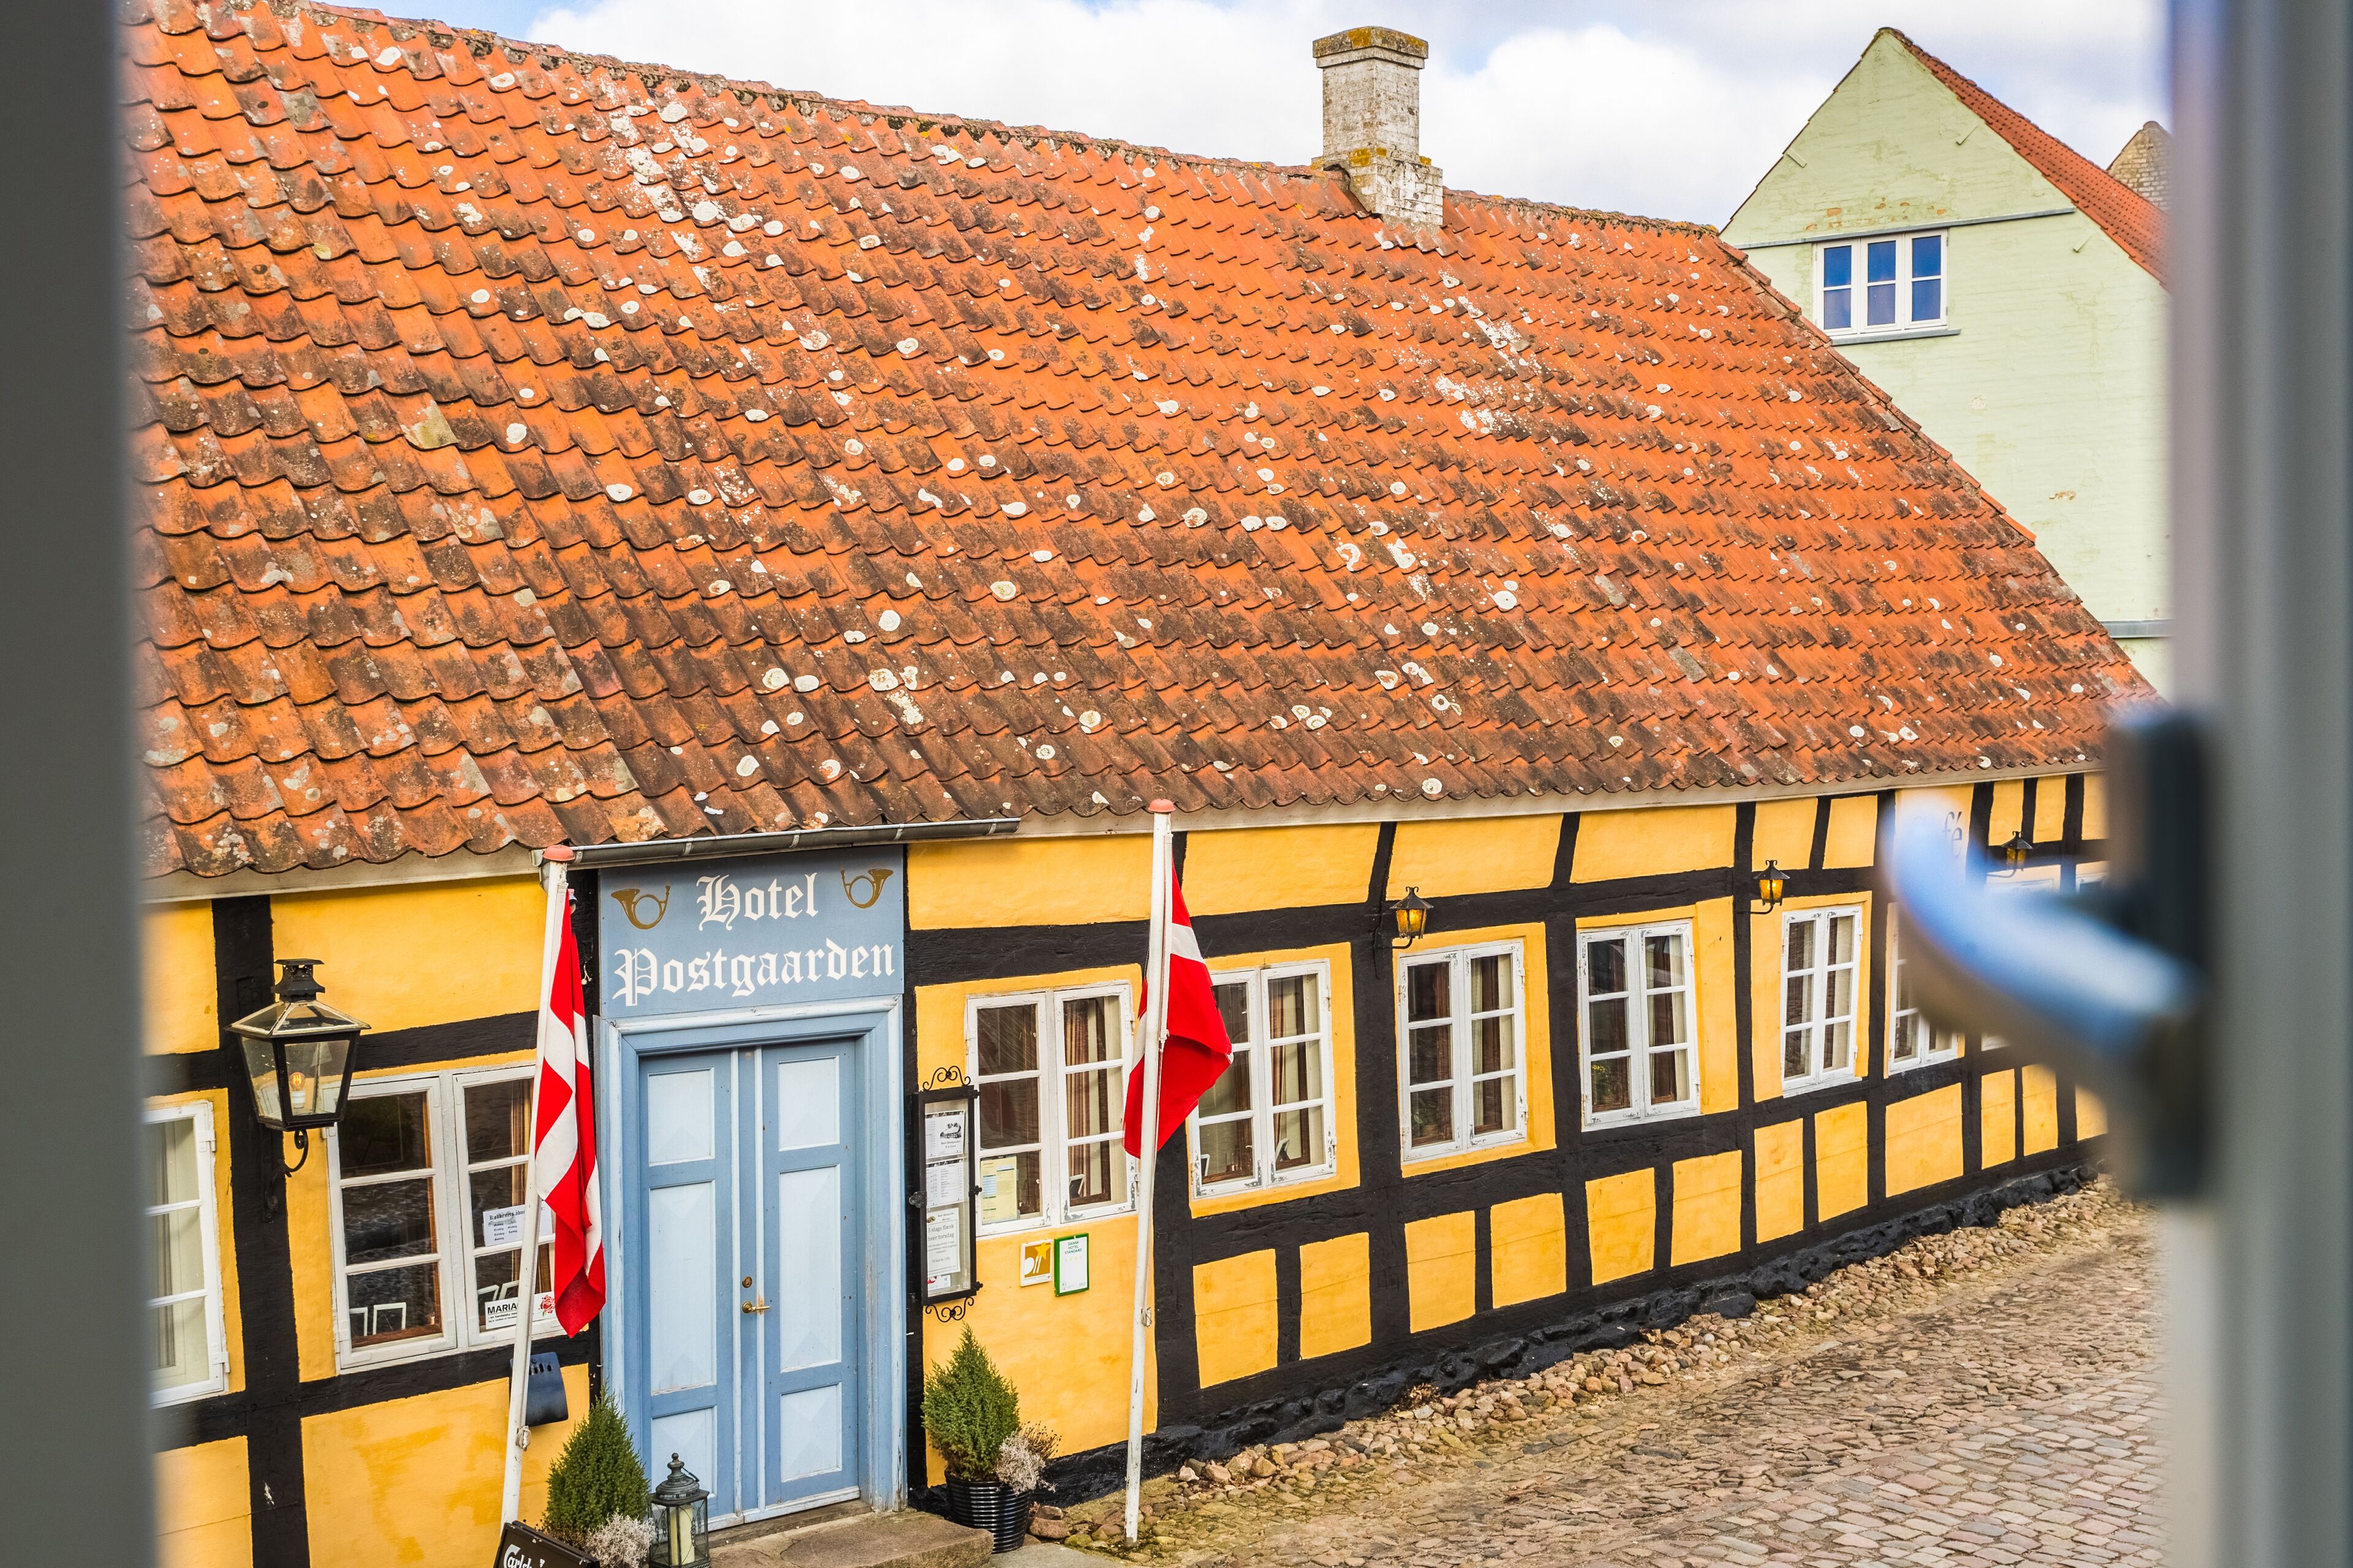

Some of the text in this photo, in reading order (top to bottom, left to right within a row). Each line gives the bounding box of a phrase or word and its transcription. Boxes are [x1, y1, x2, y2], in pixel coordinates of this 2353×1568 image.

[696, 873, 818, 931] Hotel
[613, 937, 895, 1006] Postgaarden
[487, 1303, 518, 1314] MARIA
